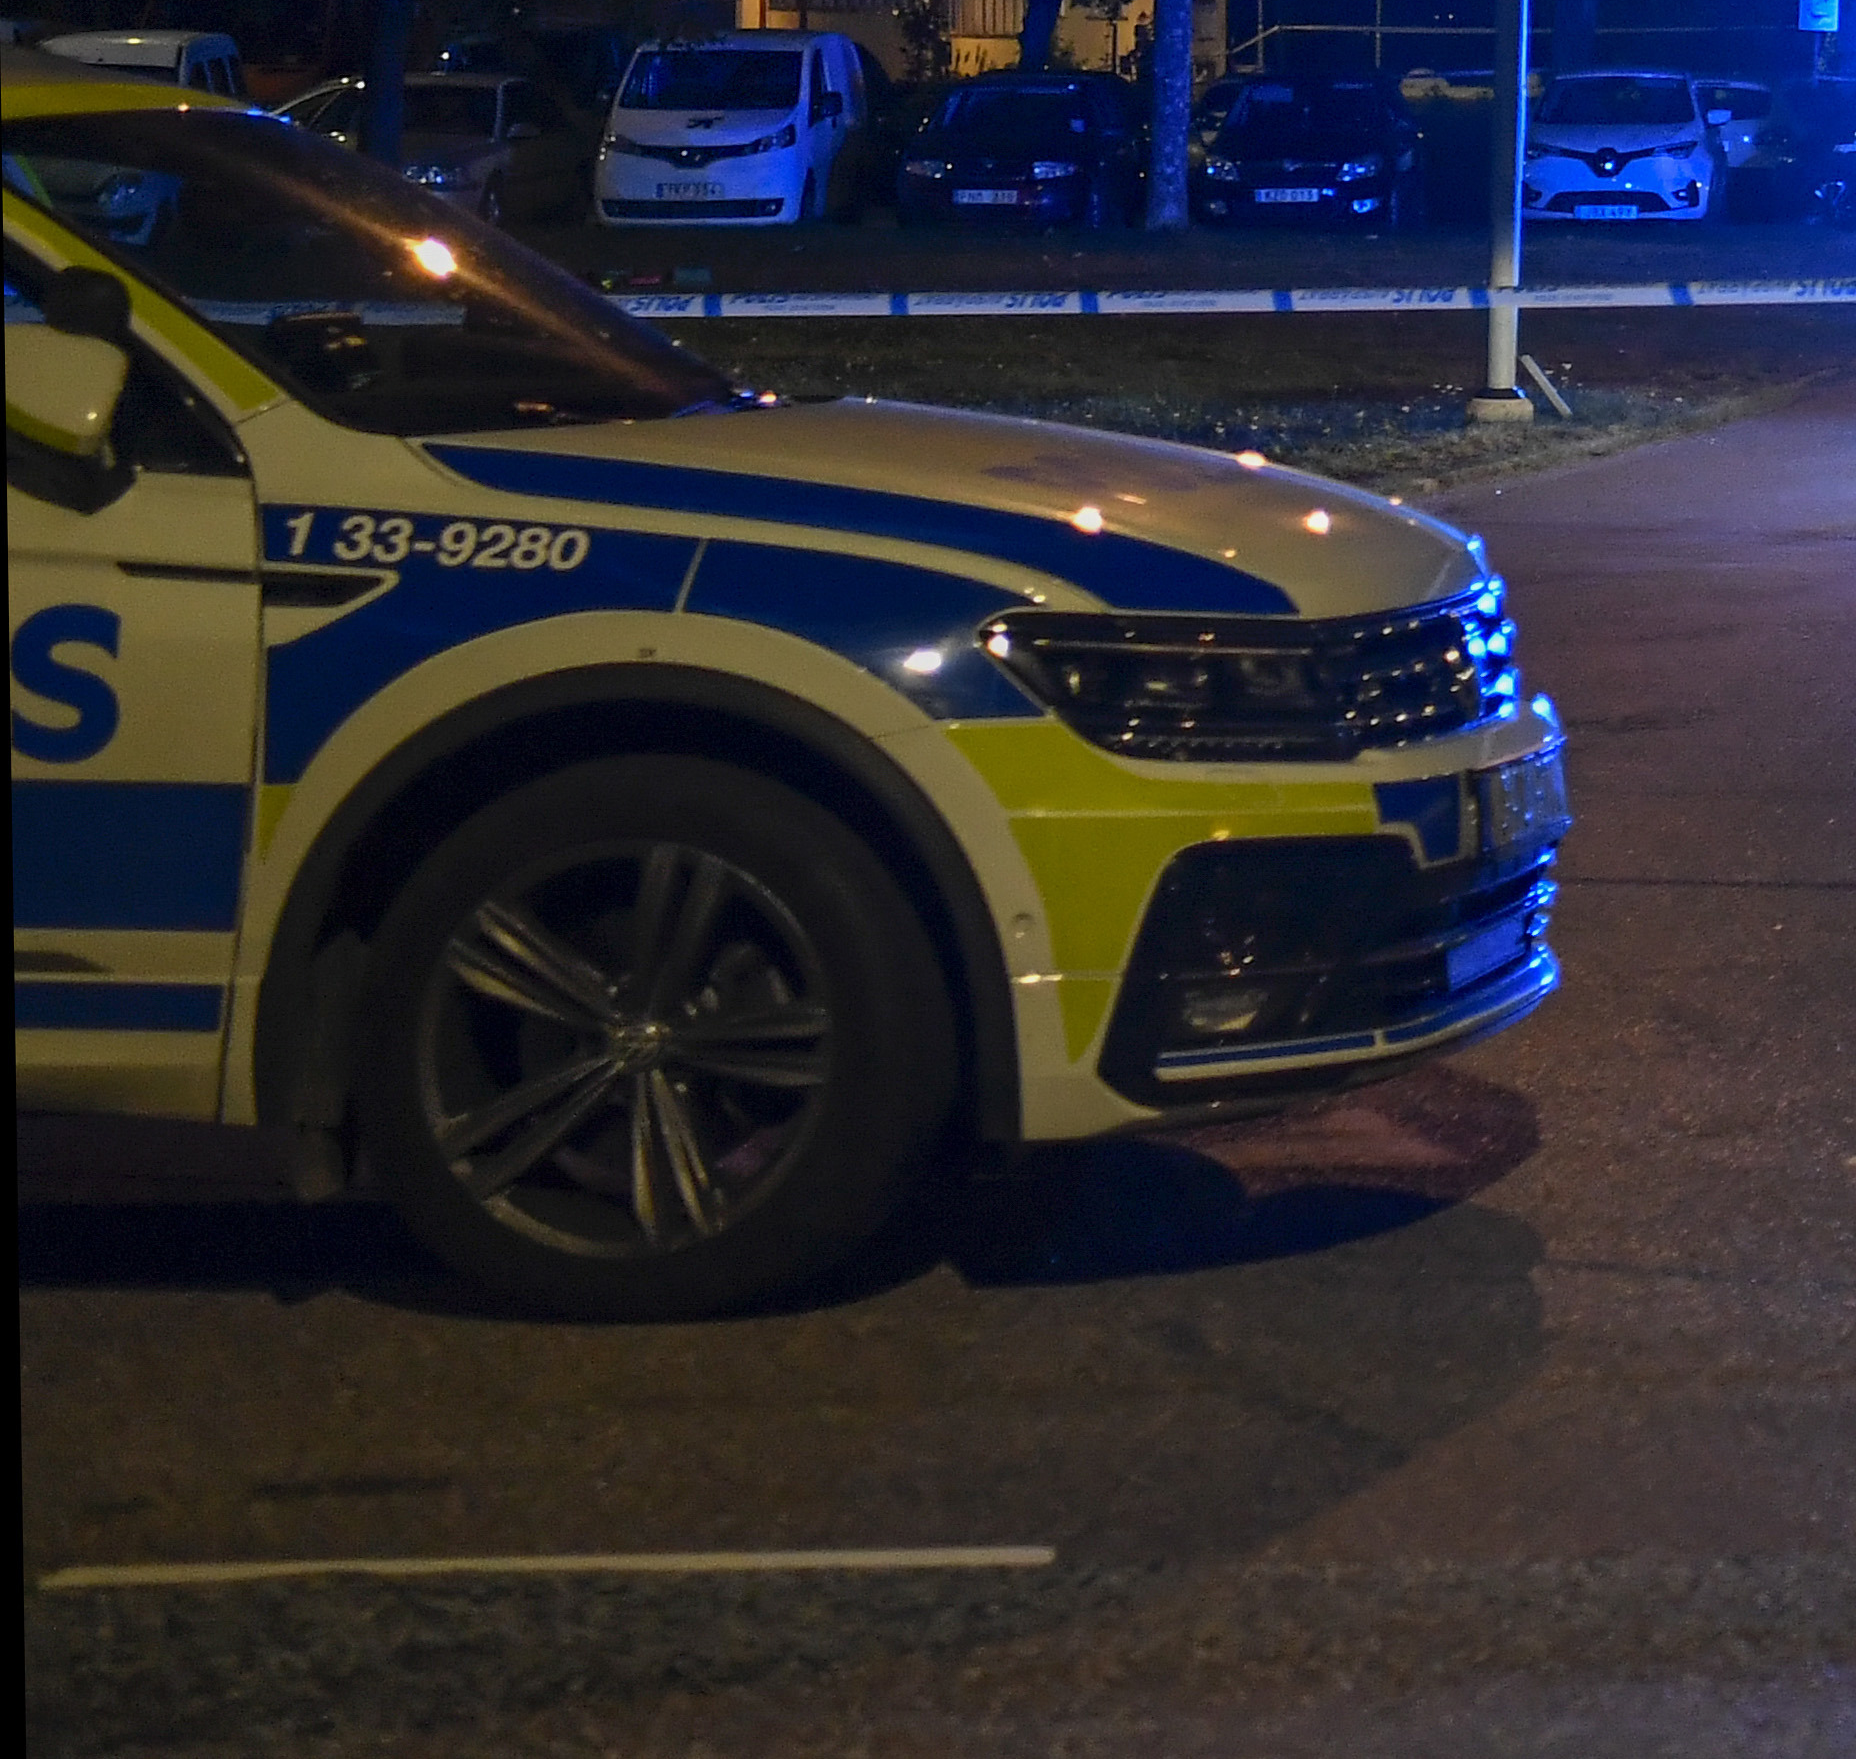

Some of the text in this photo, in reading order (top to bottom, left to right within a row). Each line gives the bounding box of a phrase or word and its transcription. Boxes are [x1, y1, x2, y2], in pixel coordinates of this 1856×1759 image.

[629, 295, 697, 312] POLIS
[286, 512, 592, 571] 1 33-9280
